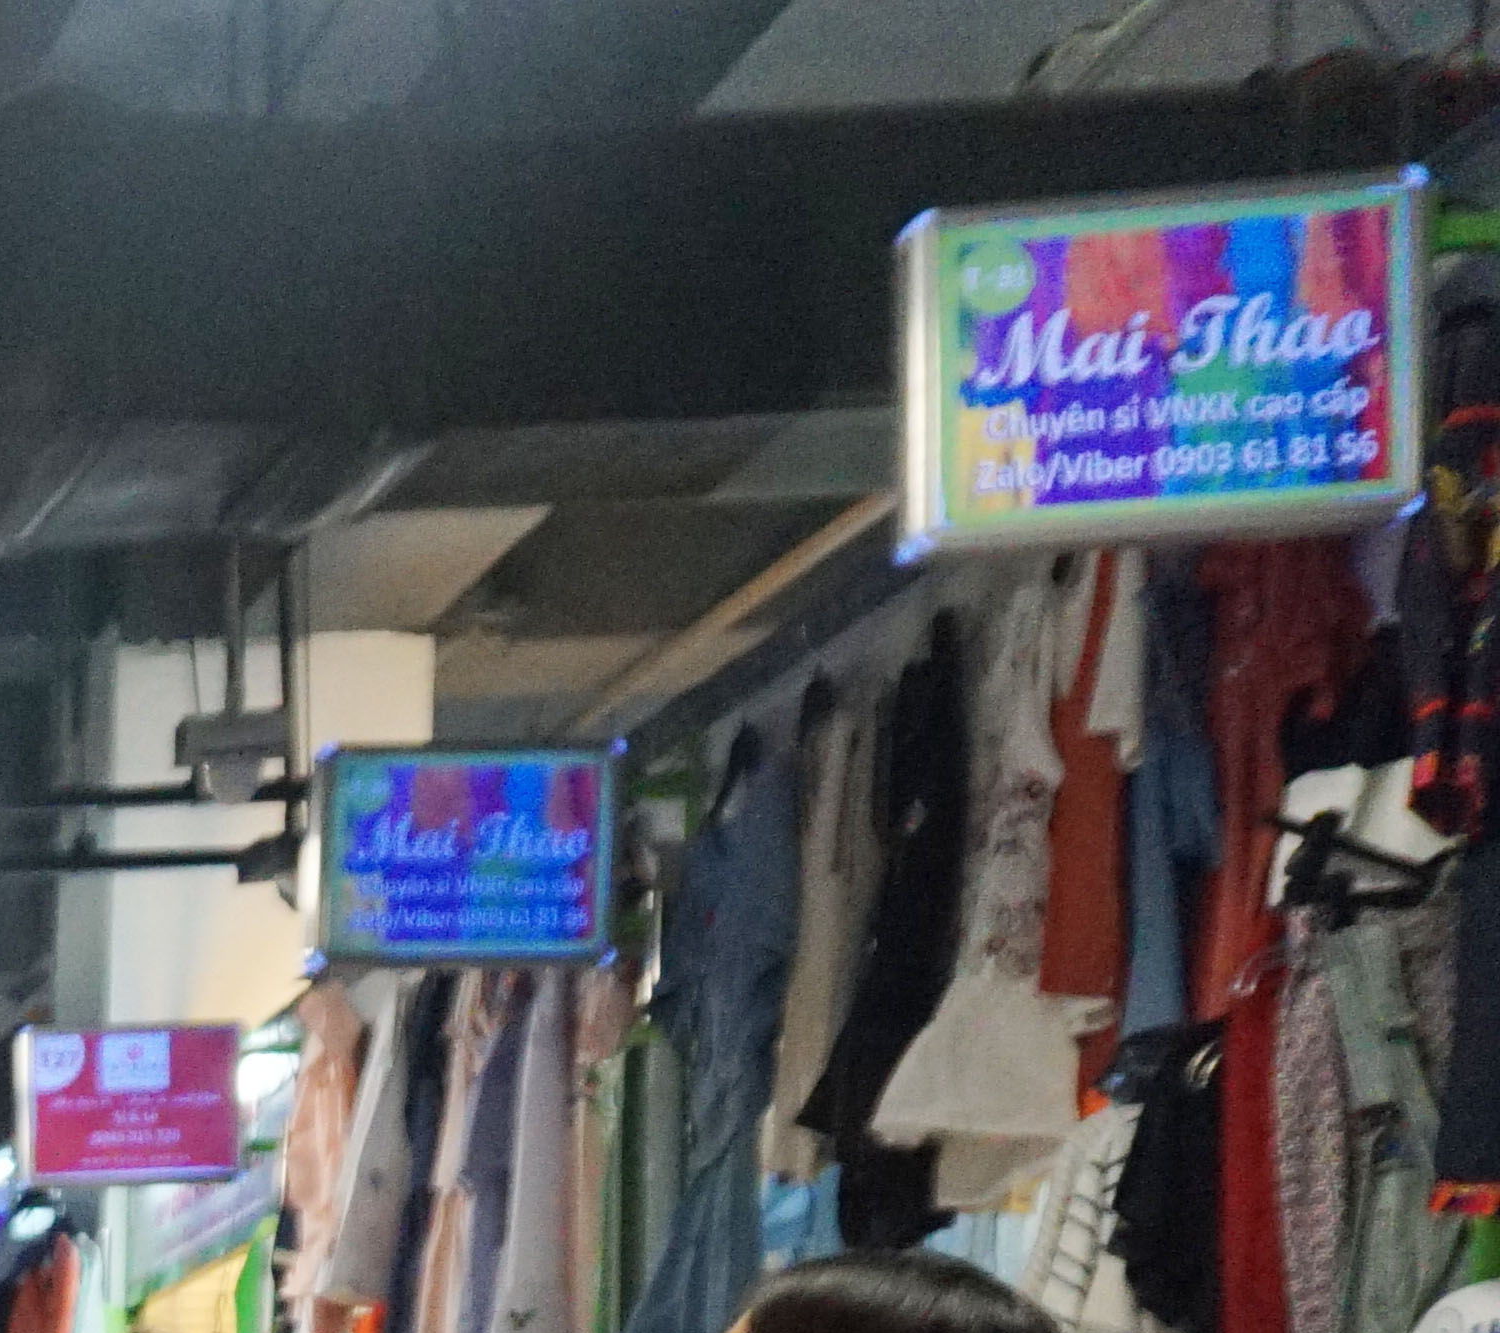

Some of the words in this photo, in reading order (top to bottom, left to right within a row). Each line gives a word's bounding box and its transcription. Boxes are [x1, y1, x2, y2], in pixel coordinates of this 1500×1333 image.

[978, 309, 1152, 387] Mai
[1167, 293, 1381, 373] Thao
[986, 399, 1106, 442] Chuyên
[1249, 391, 1304, 419] cao
[1308, 376, 1370, 420] cấp
[974, 449, 1150, 491] Zalo/Viber
[1154, 442, 1234, 477] 0903
[1240, 438, 1281, 472] 61
